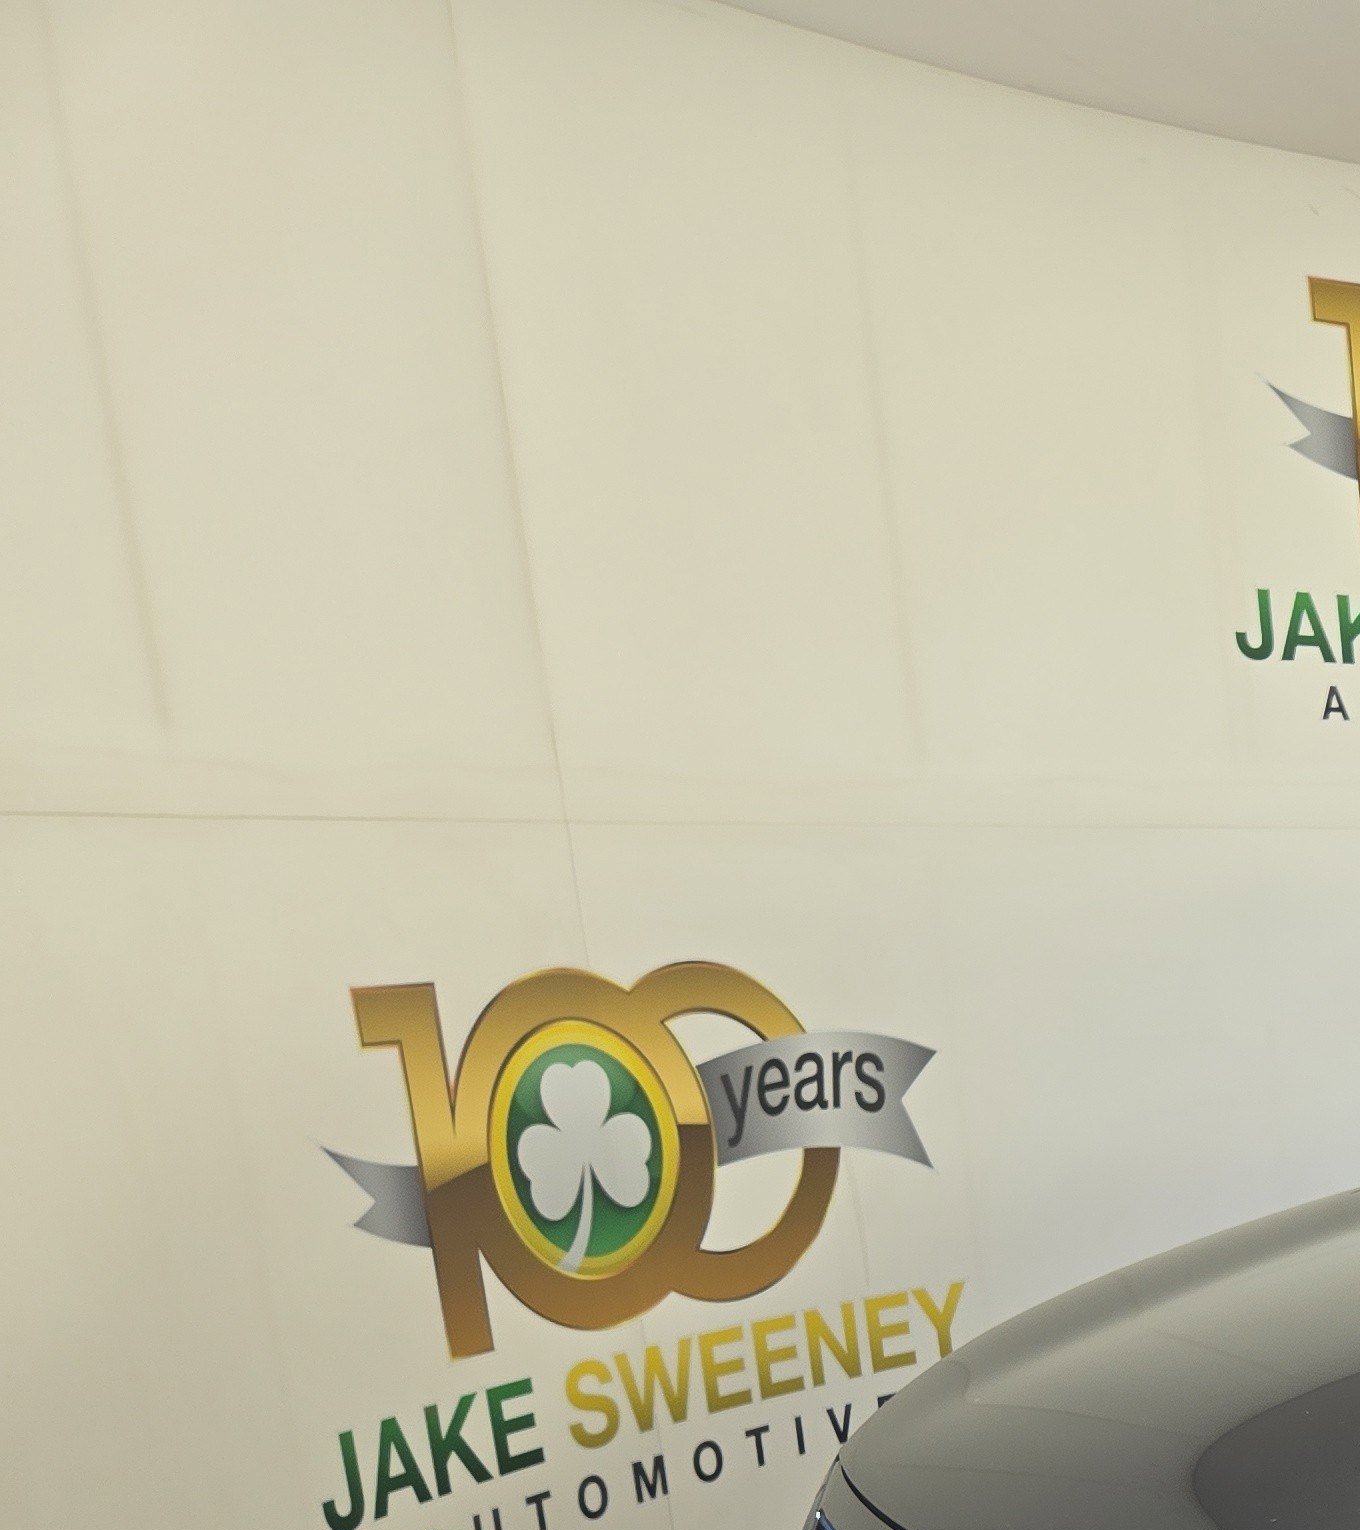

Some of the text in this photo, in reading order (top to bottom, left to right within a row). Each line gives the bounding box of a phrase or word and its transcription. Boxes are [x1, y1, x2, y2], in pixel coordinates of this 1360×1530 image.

[350, 960, 887, 1362] 100 years
[564, 1281, 966, 1450] SWEENEY
